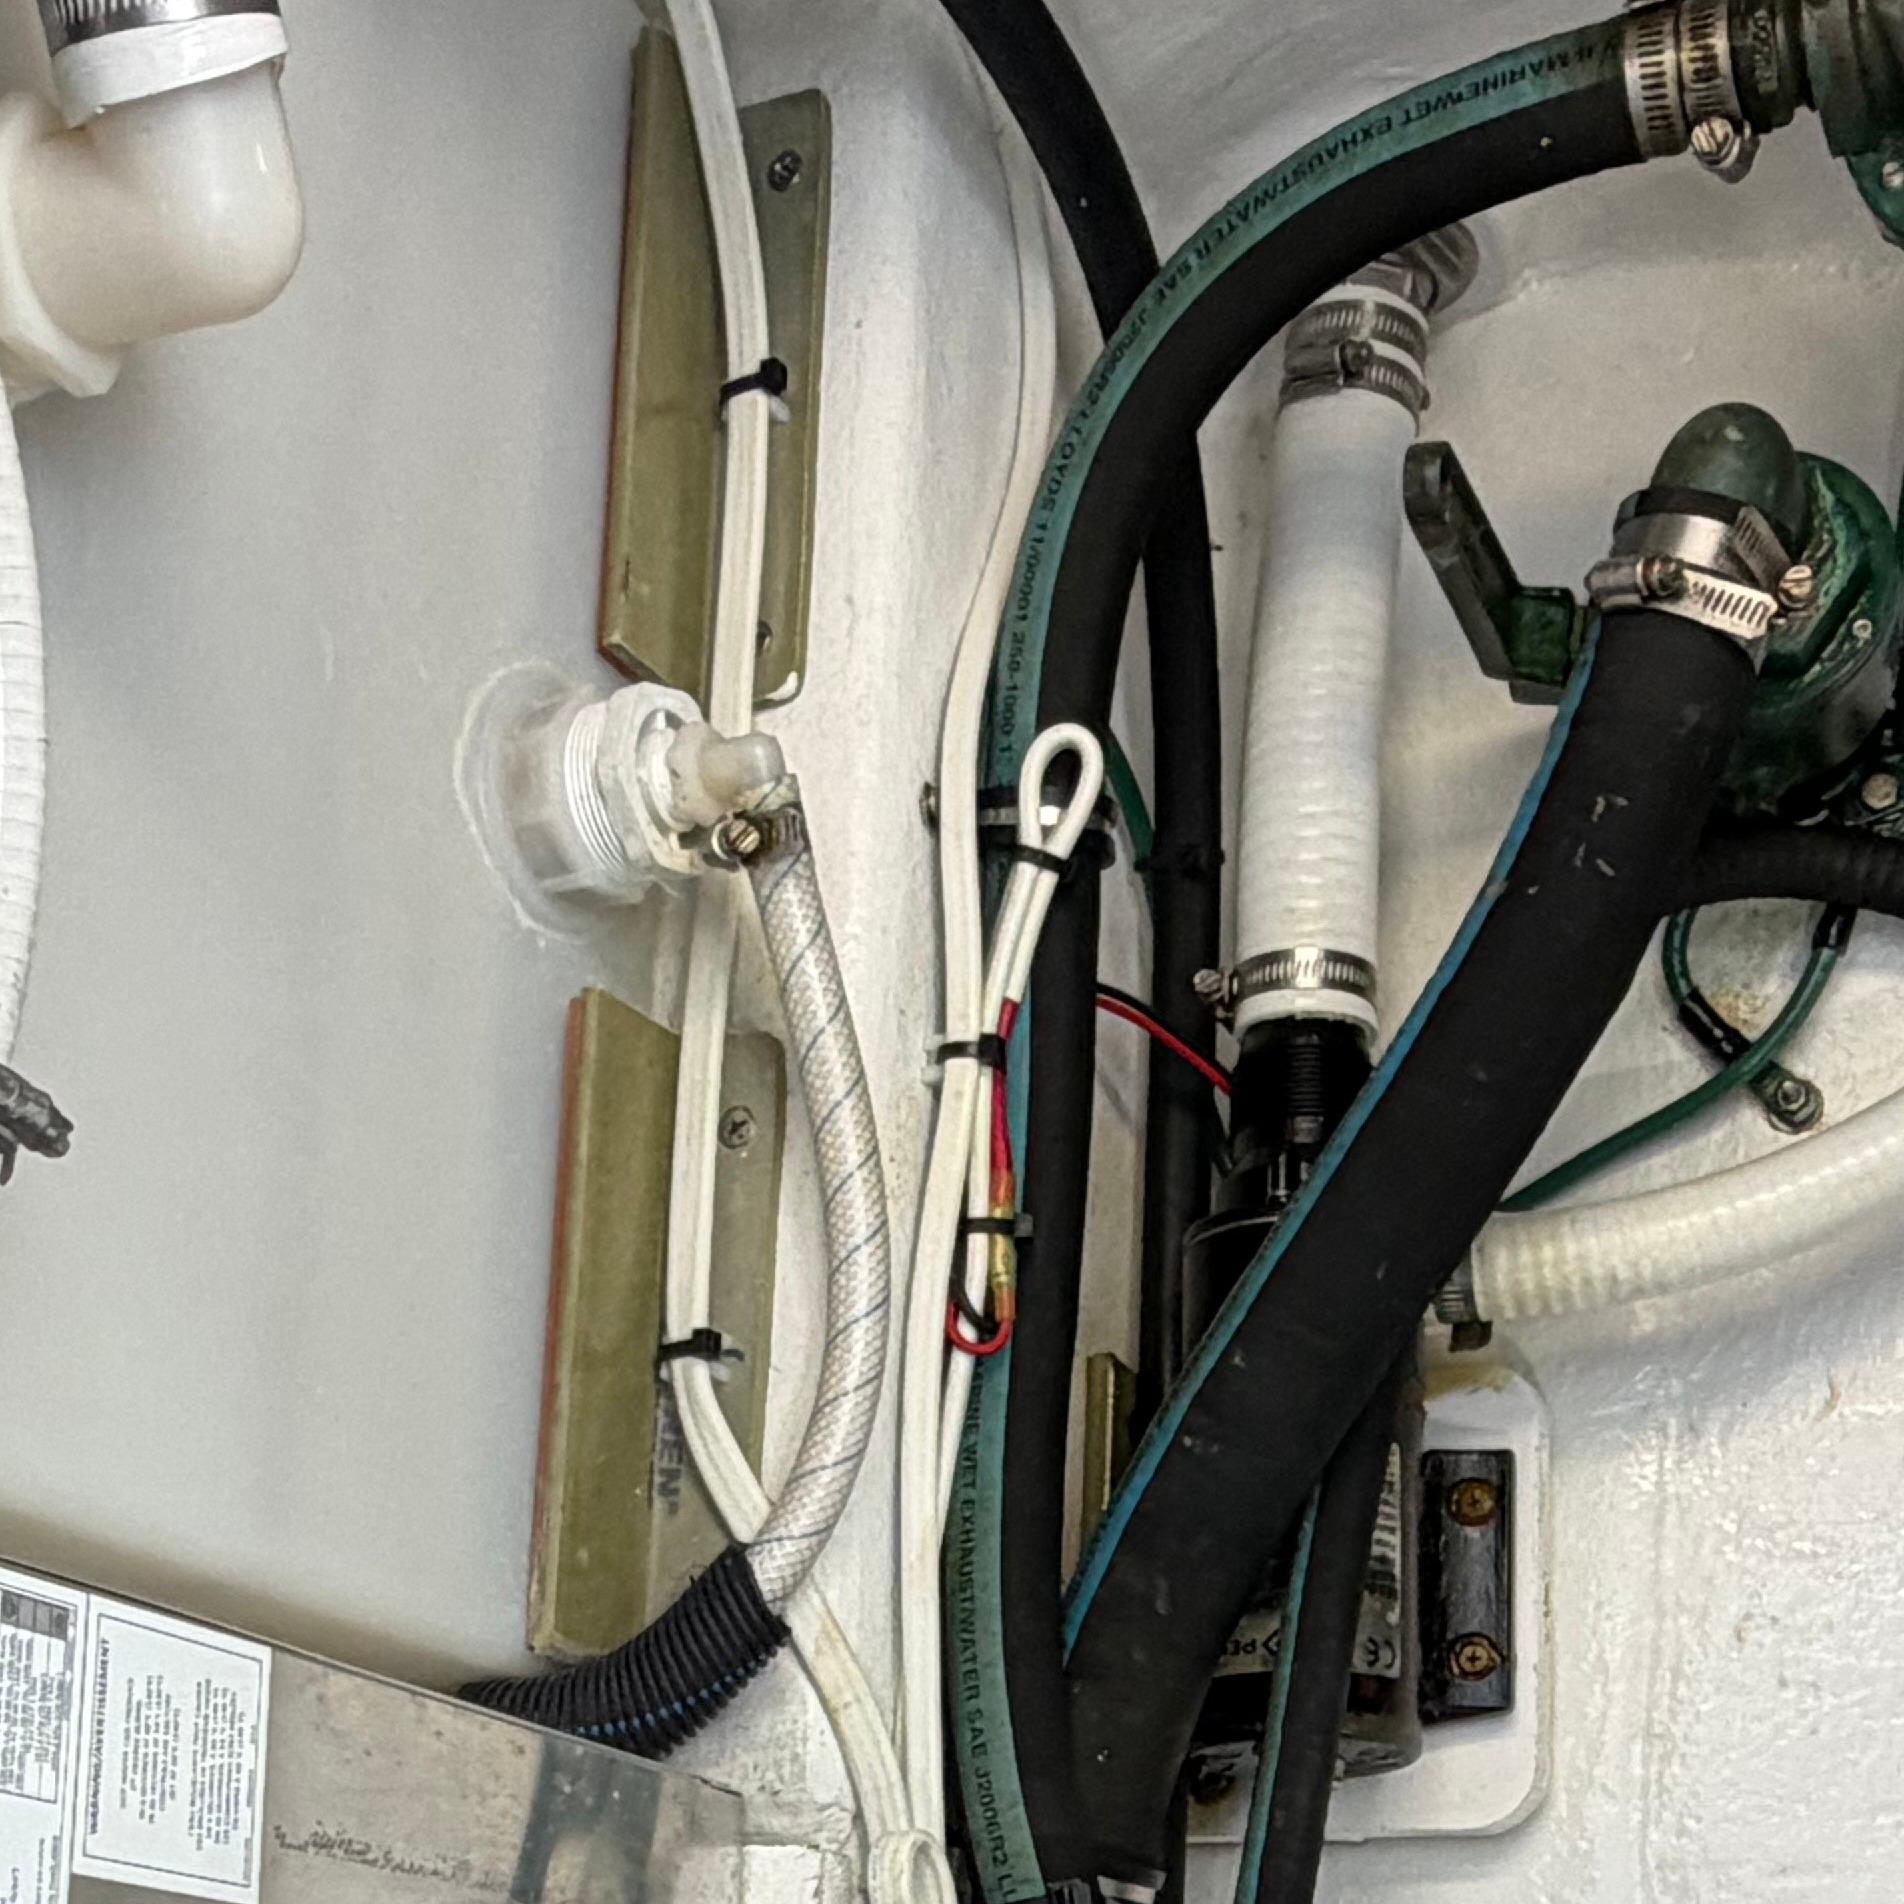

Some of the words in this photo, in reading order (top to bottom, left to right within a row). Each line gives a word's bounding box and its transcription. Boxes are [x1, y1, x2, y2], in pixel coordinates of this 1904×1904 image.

[1462, 50, 1572, 97] MARINE
[1399, 89, 1463, 126] WET
[1146, 255, 1193, 308] SAE
[962, 1439, 979, 1490] WET
[957, 1499, 981, 1700] EXHAUST/WATER
[964, 1706, 988, 1759] SAE
